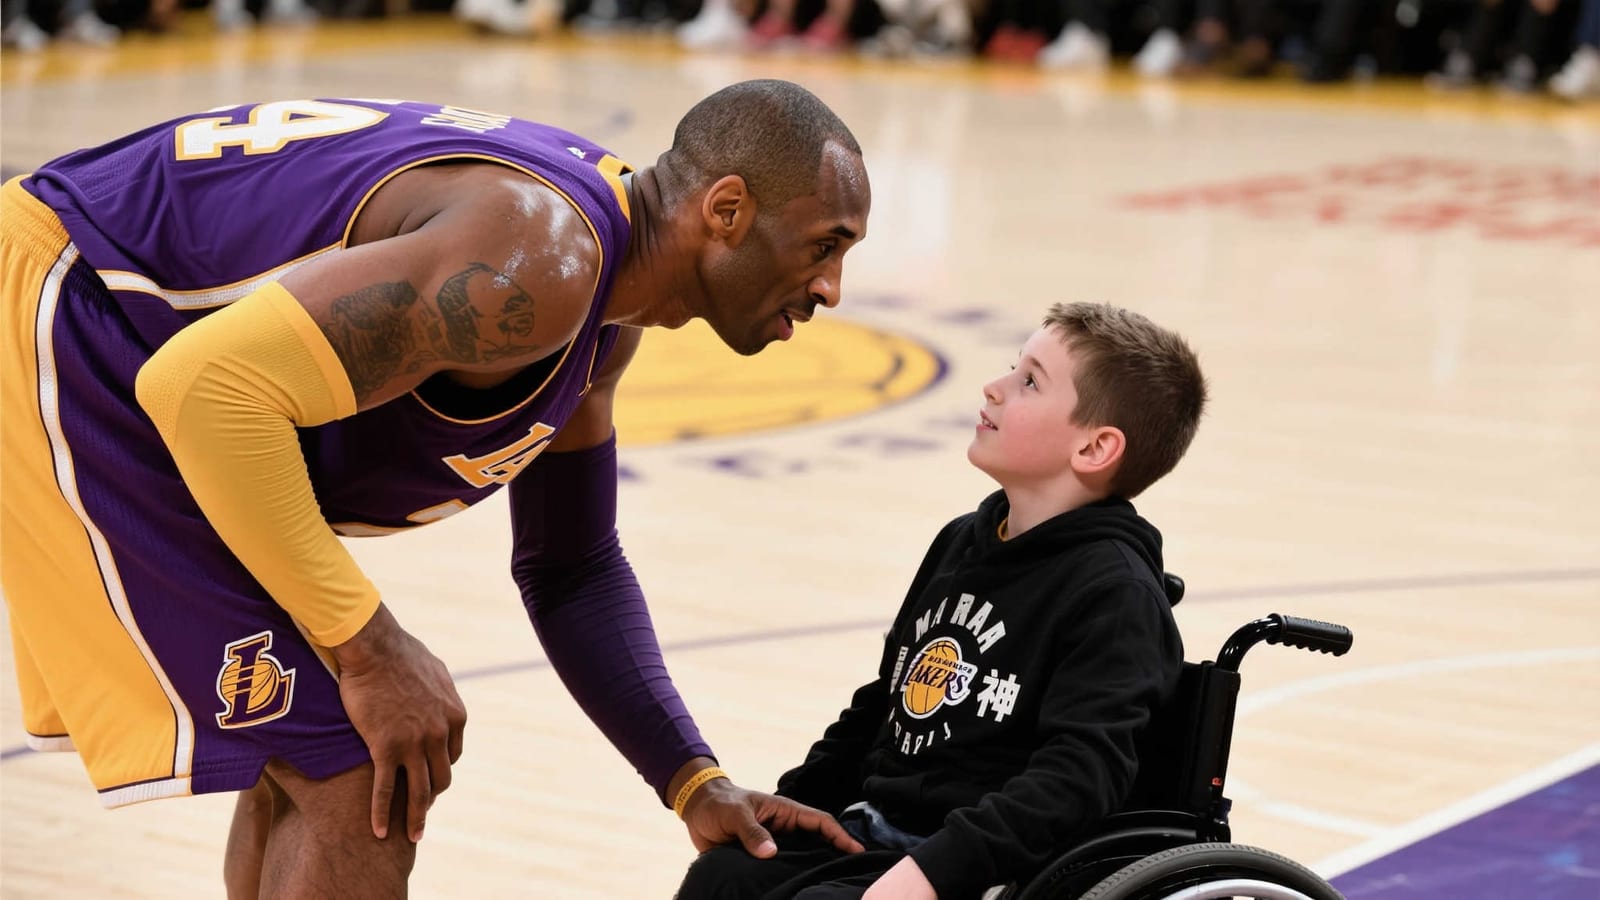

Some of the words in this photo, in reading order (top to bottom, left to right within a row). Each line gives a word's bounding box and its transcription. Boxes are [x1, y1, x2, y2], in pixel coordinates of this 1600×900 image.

[175, 98, 392, 161] 4
[903, 652, 969, 698] LAKERS
[976, 668, 1021, 723] 神
